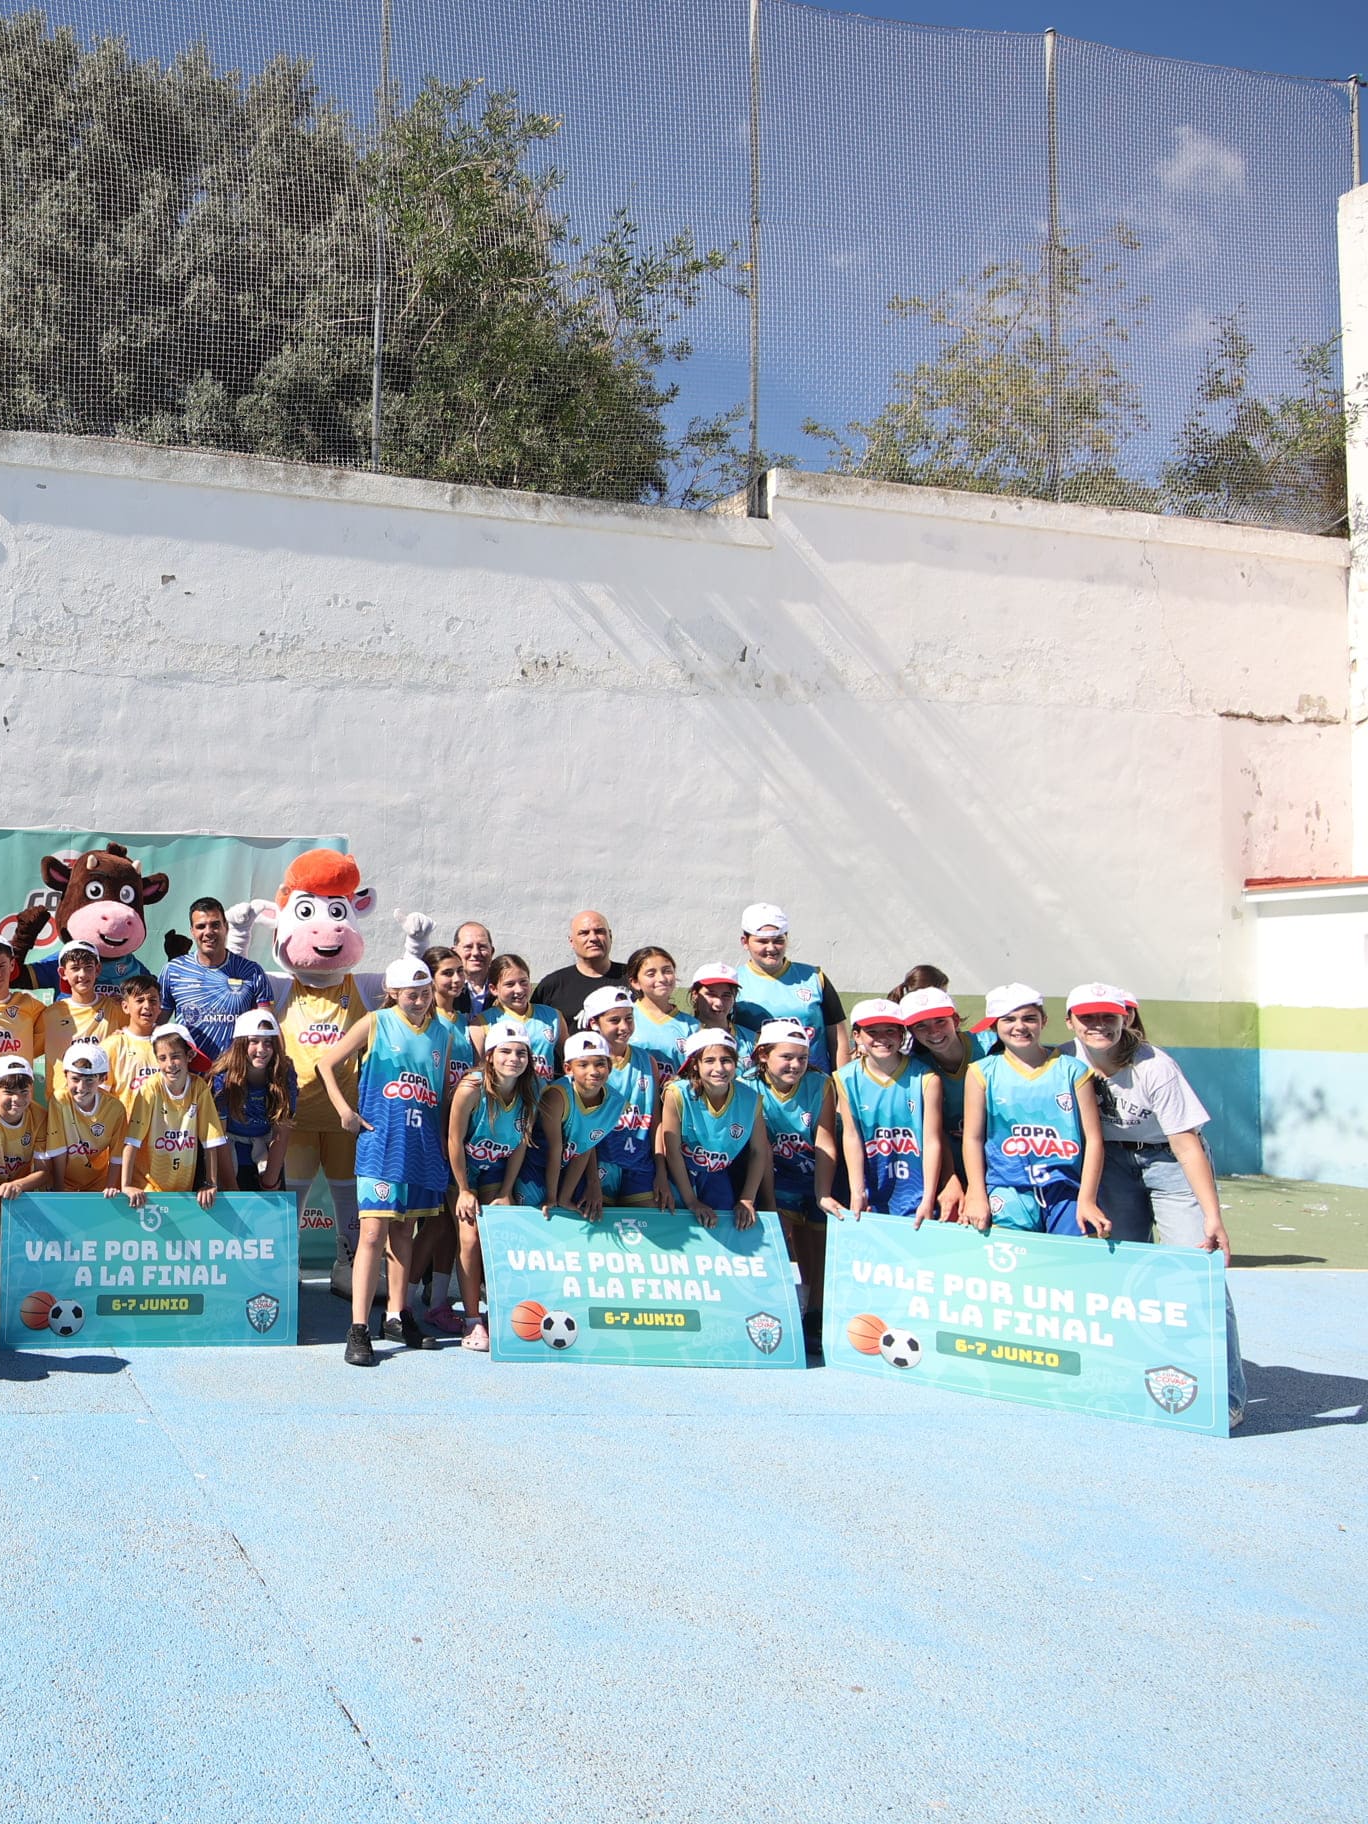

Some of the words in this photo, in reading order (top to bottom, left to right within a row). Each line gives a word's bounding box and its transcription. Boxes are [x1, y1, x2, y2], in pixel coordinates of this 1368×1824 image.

[94, 985, 121, 994] COPA
[203, 1014, 238, 1023] ANTIO
[310, 1024, 339, 1033] COPA
[450, 1061, 469, 1071] OPA
[658, 1063, 674, 1073] PA
[400, 1073, 428, 1087] COPA
[405, 1108, 423, 1128] 15
[875, 1128, 913, 1139] COPA
[1011, 1126, 1058, 1138] COPA
[154, 1136, 196, 1152] COVAP
[624, 1137, 637, 1154] 4
[865, 1138, 920, 1157] COVA
[1002, 1137, 1079, 1158] COVAP
[172, 1158, 181, 1171] 5
[885, 1160, 910, 1180] 16
[1024, 1163, 1052, 1184] 15
[136, 1204, 163, 1232] 13
[303, 1209, 323, 1217] OPA
[613, 1218, 642, 1245] 13
[24, 1241, 97, 1262] VALE
[104, 1240, 158, 1261] POR
[165, 1239, 201, 1261] UN
[208, 1239, 275, 1260] PASE
[984, 1242, 1018, 1273] 13
[507, 1249, 582, 1272] VALE
[588, 1251, 646, 1274] POR
[650, 1253, 690, 1276] UN
[695, 1255, 768, 1278] PASE
[75, 1266, 92, 1286] A
[100, 1265, 135, 1286] LA
[142, 1265, 227, 1286] FINAL
[563, 1276, 581, 1298] A
[588, 1277, 625, 1299] LA
[631, 1277, 721, 1302] FINAL
[851, 1260, 936, 1294] VALE
[943, 1273, 1014, 1306] POR
[1023, 1284, 1075, 1314] UN
[1085, 1291, 1189, 1328] PASE
[111, 1298, 136, 1311] 6-7
[139, 1298, 189, 1311] JUNIO
[604, 1311, 630, 1325] 6-7
[633, 1312, 686, 1327] JUNIO
[907, 1295, 930, 1320] A
[938, 1299, 984, 1329] LA
[992, 1307, 1114, 1348] FINAL
[954, 1338, 987, 1355] 6-7
[991, 1344, 1060, 1368] JUNIO
